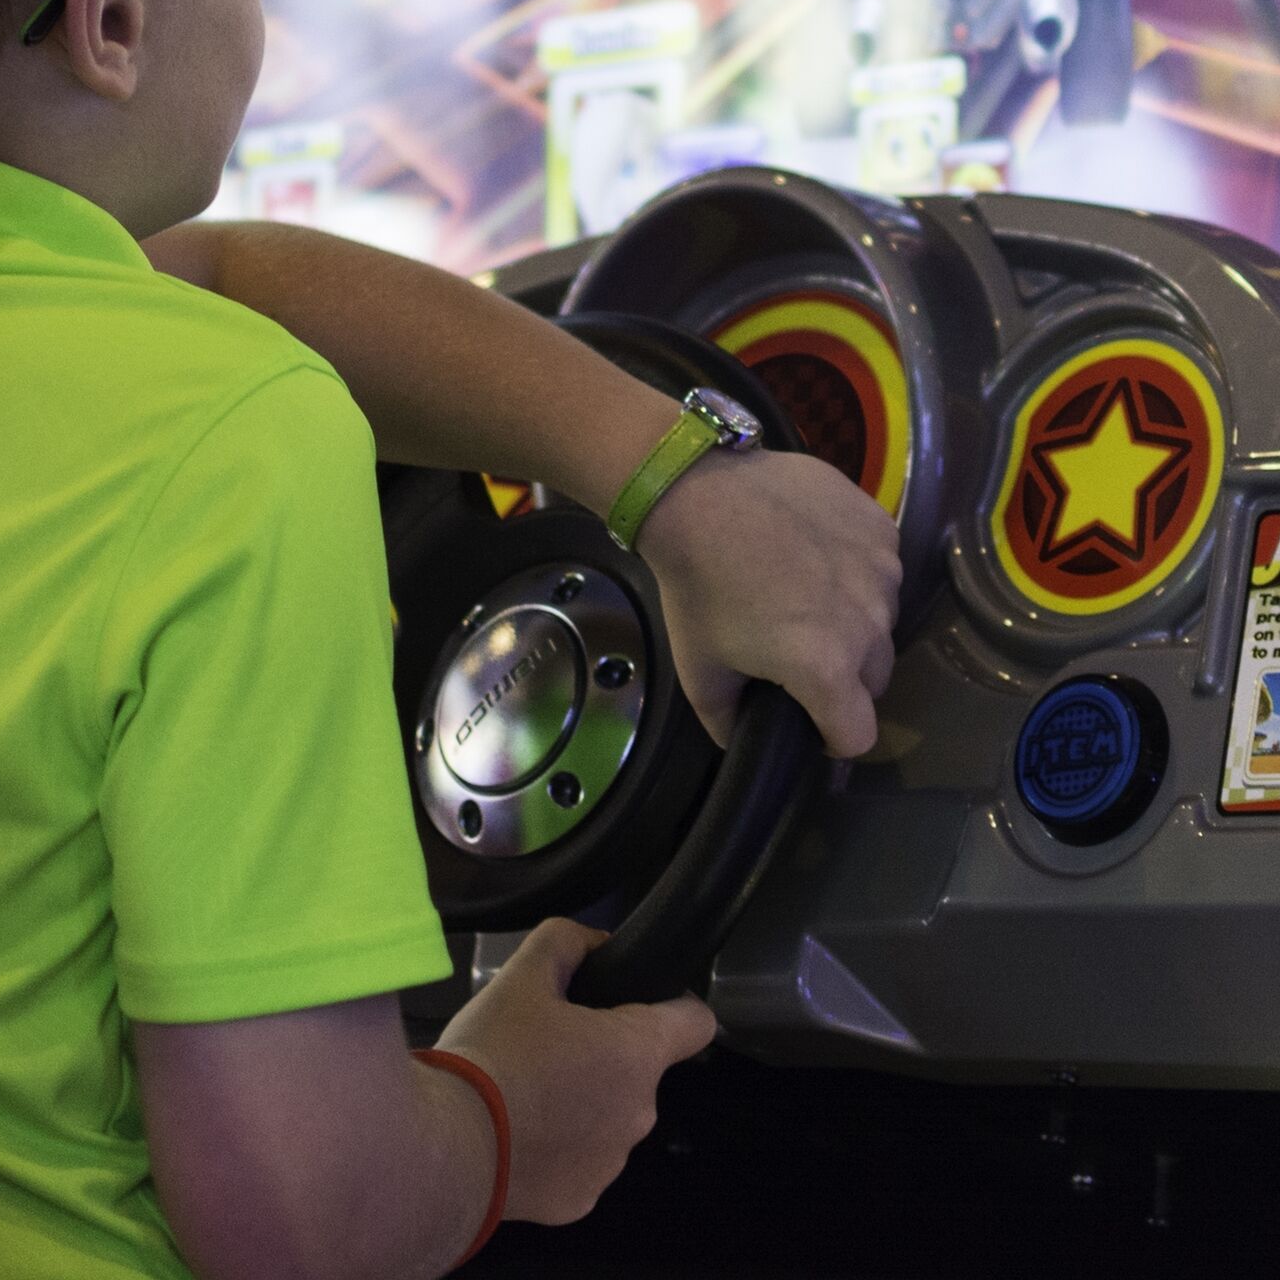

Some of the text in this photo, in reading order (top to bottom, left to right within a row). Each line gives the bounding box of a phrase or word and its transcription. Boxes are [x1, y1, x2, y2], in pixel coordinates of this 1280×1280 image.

[1254, 629, 1274, 641] on
[1252, 645, 1268, 658] to
[1027, 729, 1119, 770] ITEM
